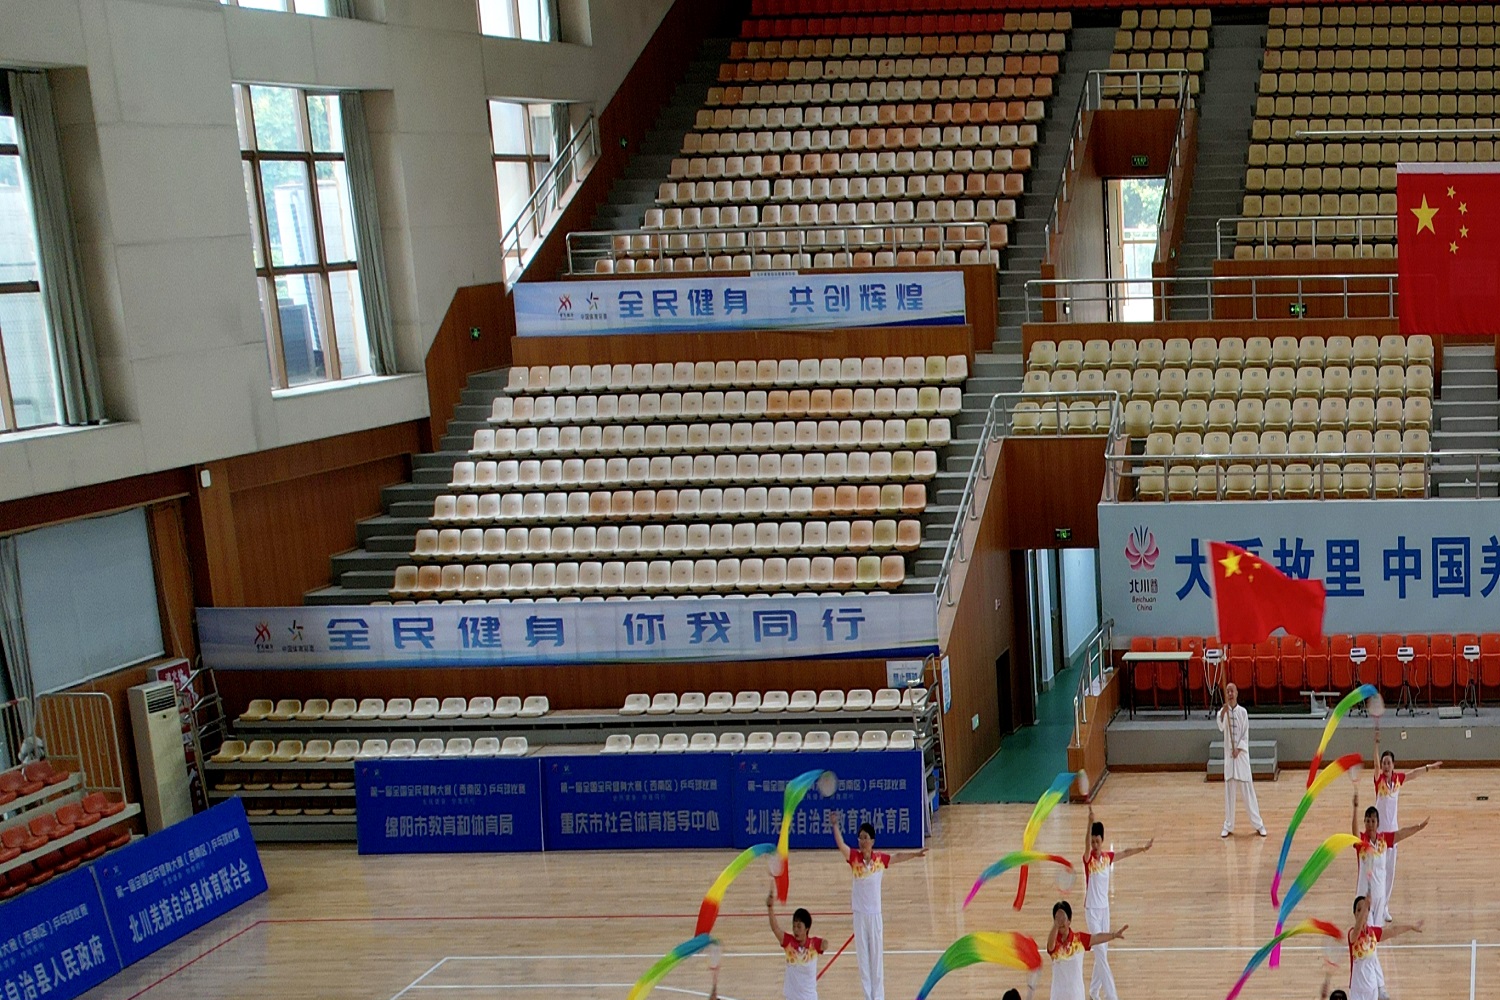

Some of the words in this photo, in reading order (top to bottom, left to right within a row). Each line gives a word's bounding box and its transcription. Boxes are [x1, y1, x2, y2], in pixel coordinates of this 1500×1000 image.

[617, 287, 748, 318] 全民健身
[789, 283, 924, 313] 共创辉煌
[1175, 536, 1365, 600] 大故里
[1131, 595, 1157, 603] Beichuan
[1136, 604, 1153, 612] China
[327, 616, 566, 650] 全民健身
[622, 607, 868, 645] 你我同行
[384, 813, 514, 838] 绵阳市教育和体育局
[560, 809, 720, 835] 重庆市社会体育指导中心
